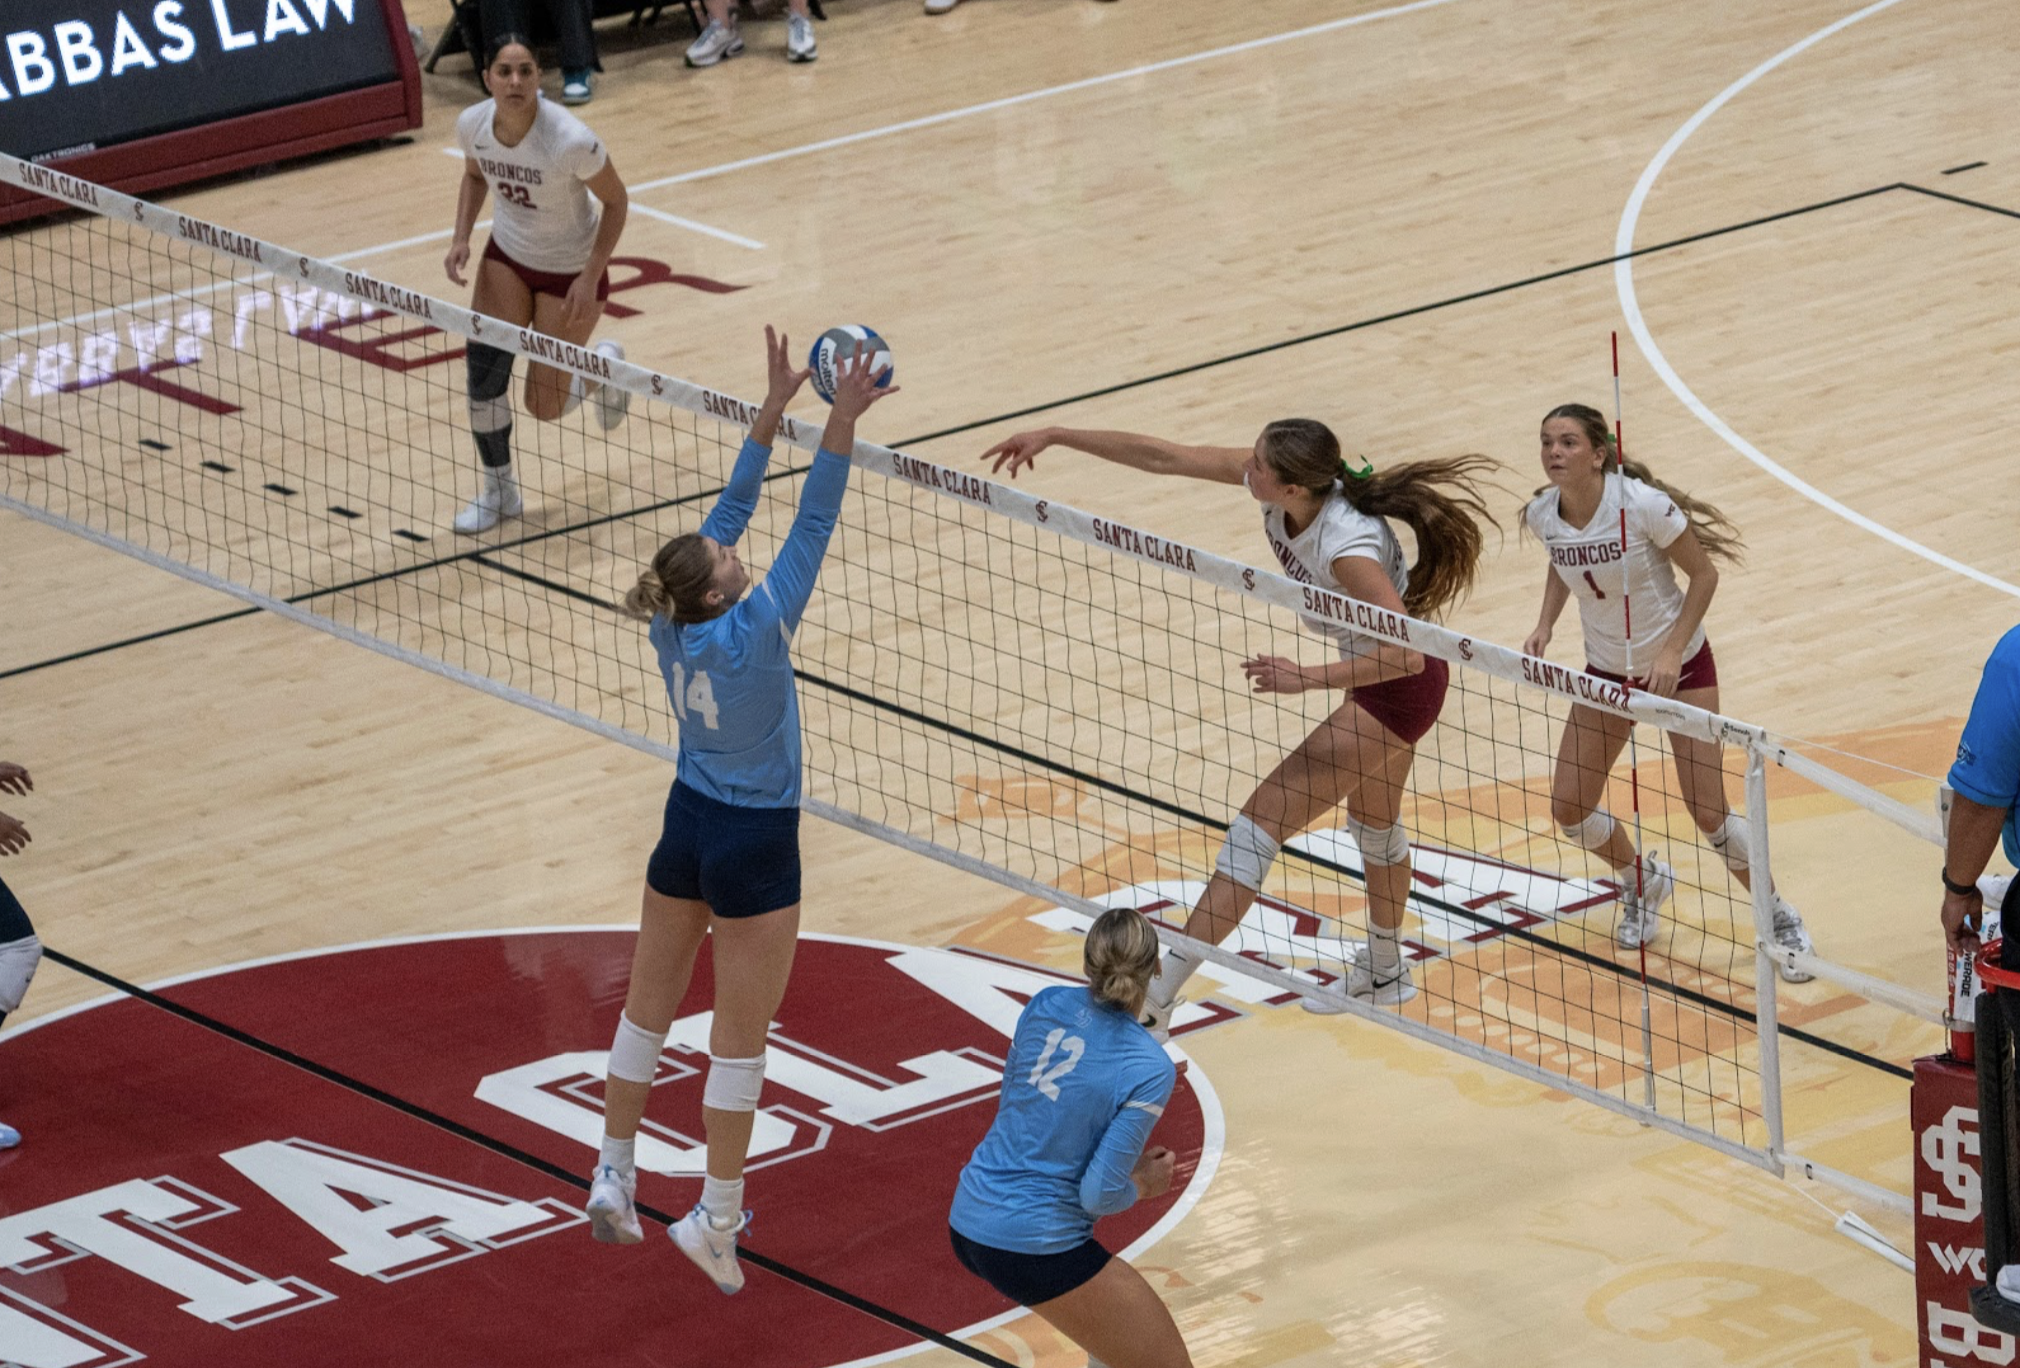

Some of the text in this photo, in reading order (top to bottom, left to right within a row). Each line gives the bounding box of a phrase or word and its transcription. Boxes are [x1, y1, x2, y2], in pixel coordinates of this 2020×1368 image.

[0, 0, 196, 99] BBAS
[18, 162, 99, 207] SANTA CLARA
[480, 157, 543, 185] BRONCOS
[178, 215, 263, 263] SANTA CLARA
[345, 272, 433, 319] SANTA CLARA
[519, 330, 611, 380] SANTA CLARA
[703, 390, 749, 426] SANTA
[892, 453, 992, 505] SANTA CLARA
[1093, 518, 1197, 573] SANTA CLARA
[1550, 541, 1622, 567] BRONCOS
[1583, 570, 1606, 600] 1
[1302, 586, 1411, 643] SANTA CLARA
[672, 661, 720, 731] 14
[1521, 657, 1634, 714] SANTA CLARA
[1960, 951, 1973, 998] WERADE
[1026, 1027, 1085, 1102] 12
